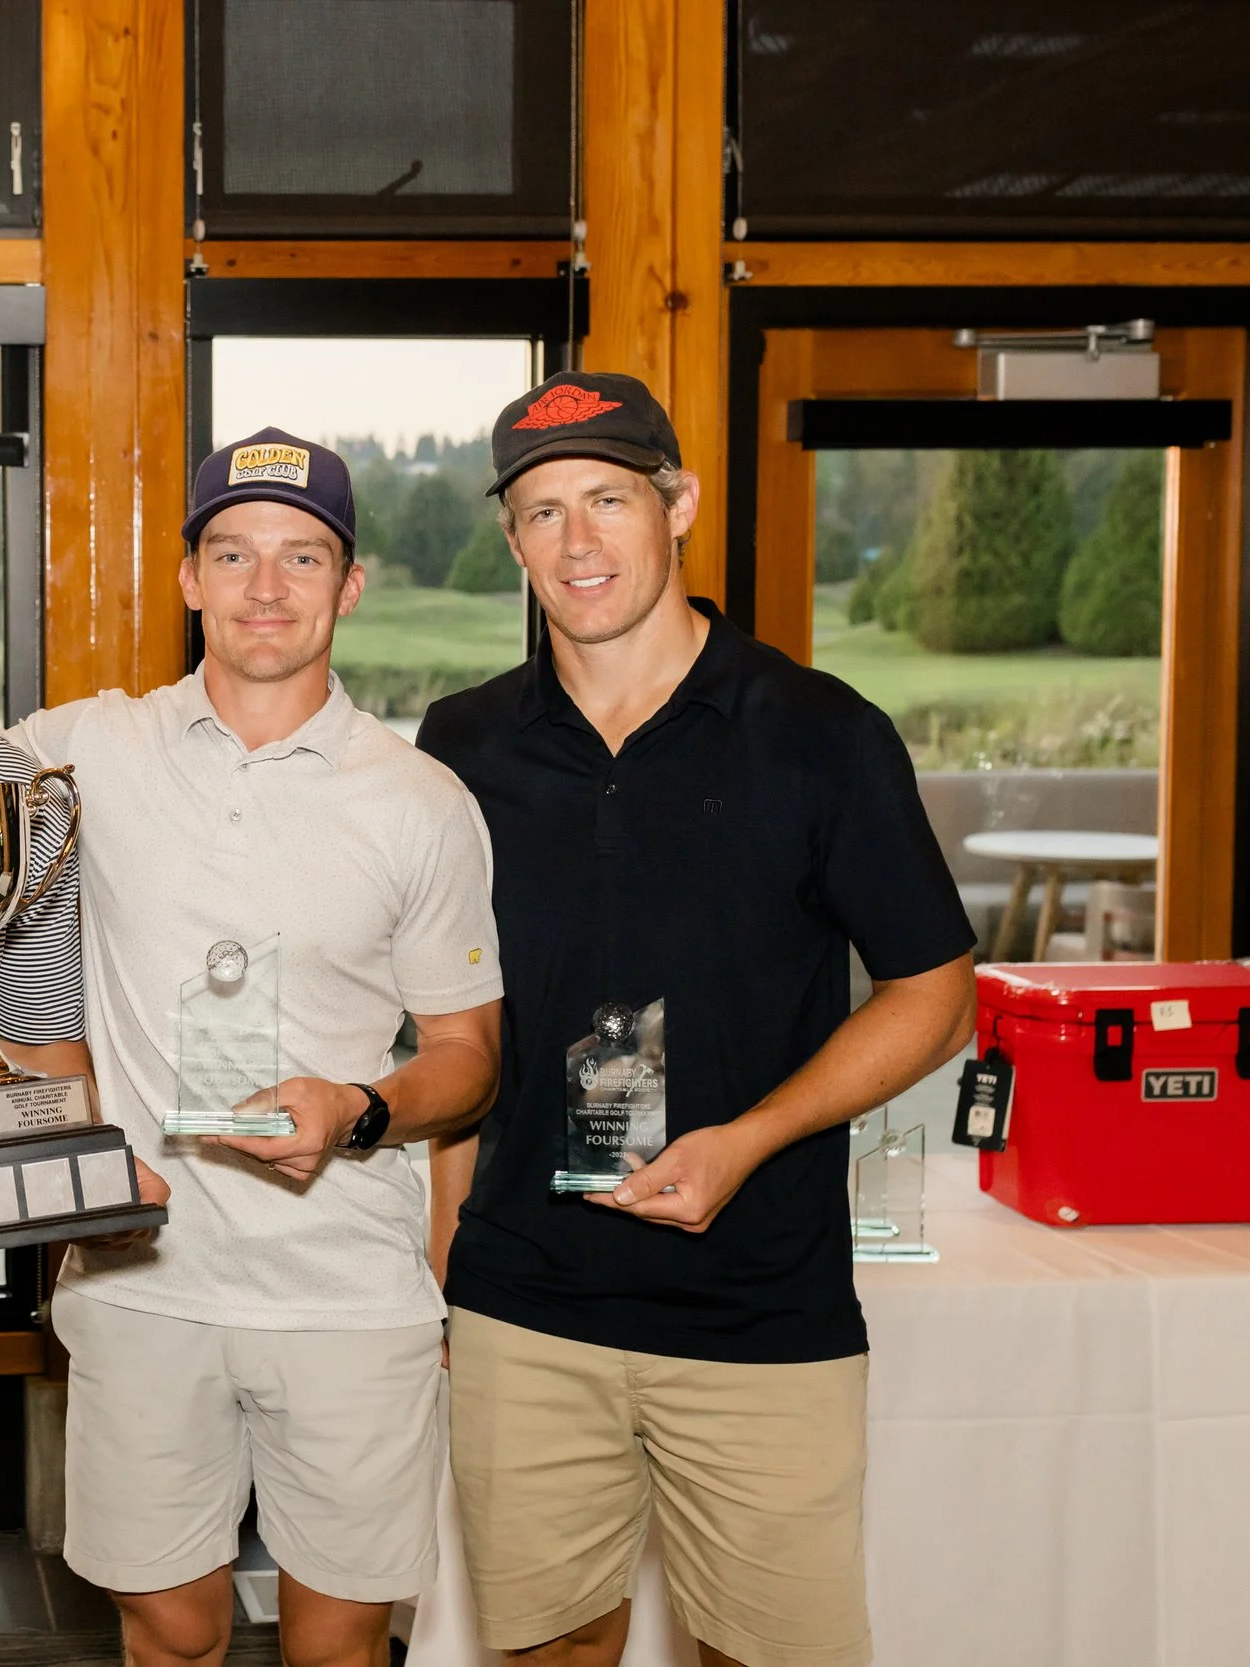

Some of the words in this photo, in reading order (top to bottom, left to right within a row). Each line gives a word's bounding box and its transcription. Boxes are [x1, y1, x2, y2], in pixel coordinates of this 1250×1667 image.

[551, 386, 597, 400] JORDAN
[235, 448, 306, 471] GOLDEN
[267, 463, 298, 480] CLUB
[600, 1068, 637, 1077] BURNABY
[600, 1078, 659, 1088] FIREFIGHTERS
[976, 1073, 998, 1085] YETI
[33, 1085, 72, 1094] FIREFIGHTERS
[1148, 1075, 1211, 1096] YETI
[34, 1092, 68, 1100] CHARITABLE
[30, 1098, 67, 1107] TOURNAMENT
[21, 1106, 63, 1118] WINNING
[17, 1115, 69, 1128] FOURSOME
[590, 1120, 649, 1132] WINNING
[586, 1135, 654, 1147] FOURSOME
